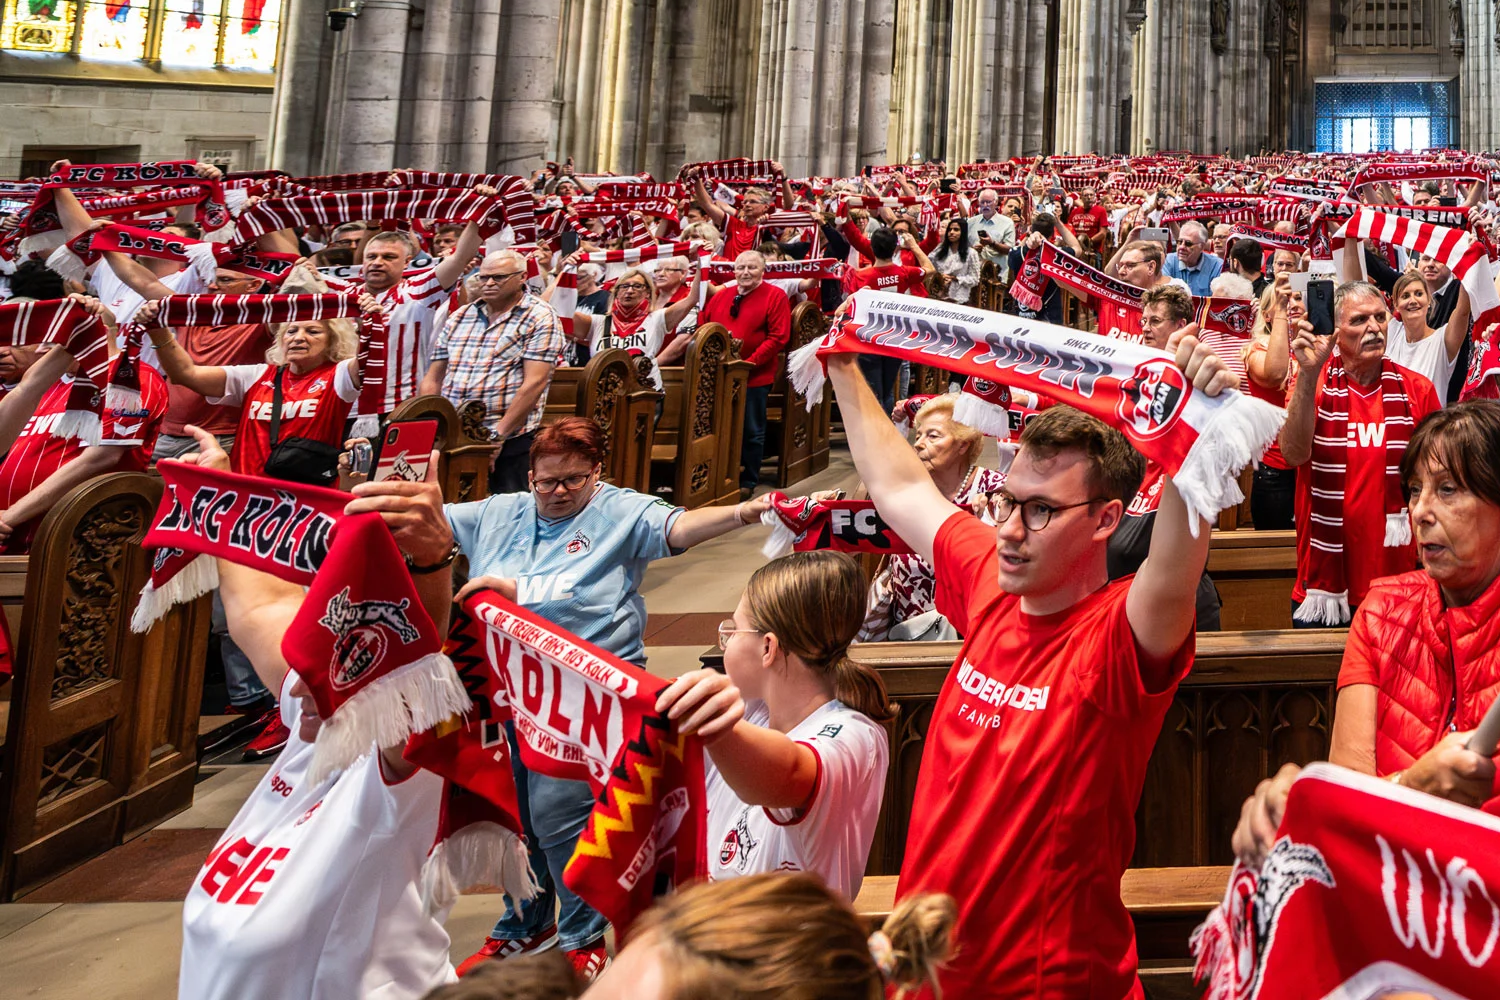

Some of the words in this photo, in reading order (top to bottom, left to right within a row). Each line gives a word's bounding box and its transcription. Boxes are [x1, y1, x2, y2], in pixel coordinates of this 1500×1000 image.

[69, 167, 105, 182] FC
[877, 274, 899, 287] RISSE
[884, 302, 901, 311] KÖLN
[901, 304, 926, 315] FANCLUB
[926, 306, 985, 324] SÜDDEUTSCHLAND
[856, 312, 975, 360] WILDER
[1063, 338, 1091, 351] SINCE
[1091, 344, 1116, 357] 1991
[974, 327, 1113, 398] SÜDEN
[1151, 382, 1171, 425] KÖLN
[1346, 422, 1386, 448] EW
[228, 487, 337, 574] KÖLN
[831, 508, 876, 535] FC
[517, 574, 577, 605] WE
[494, 611, 510, 629] DIE
[508, 618, 543, 644] TREUEN
[540, 634, 568, 656] FANS
[563, 648, 588, 668] AUS
[491, 630, 612, 759] KÖLN
[538, 732, 559, 757] VOM
[1374, 833, 1500, 968] WO
